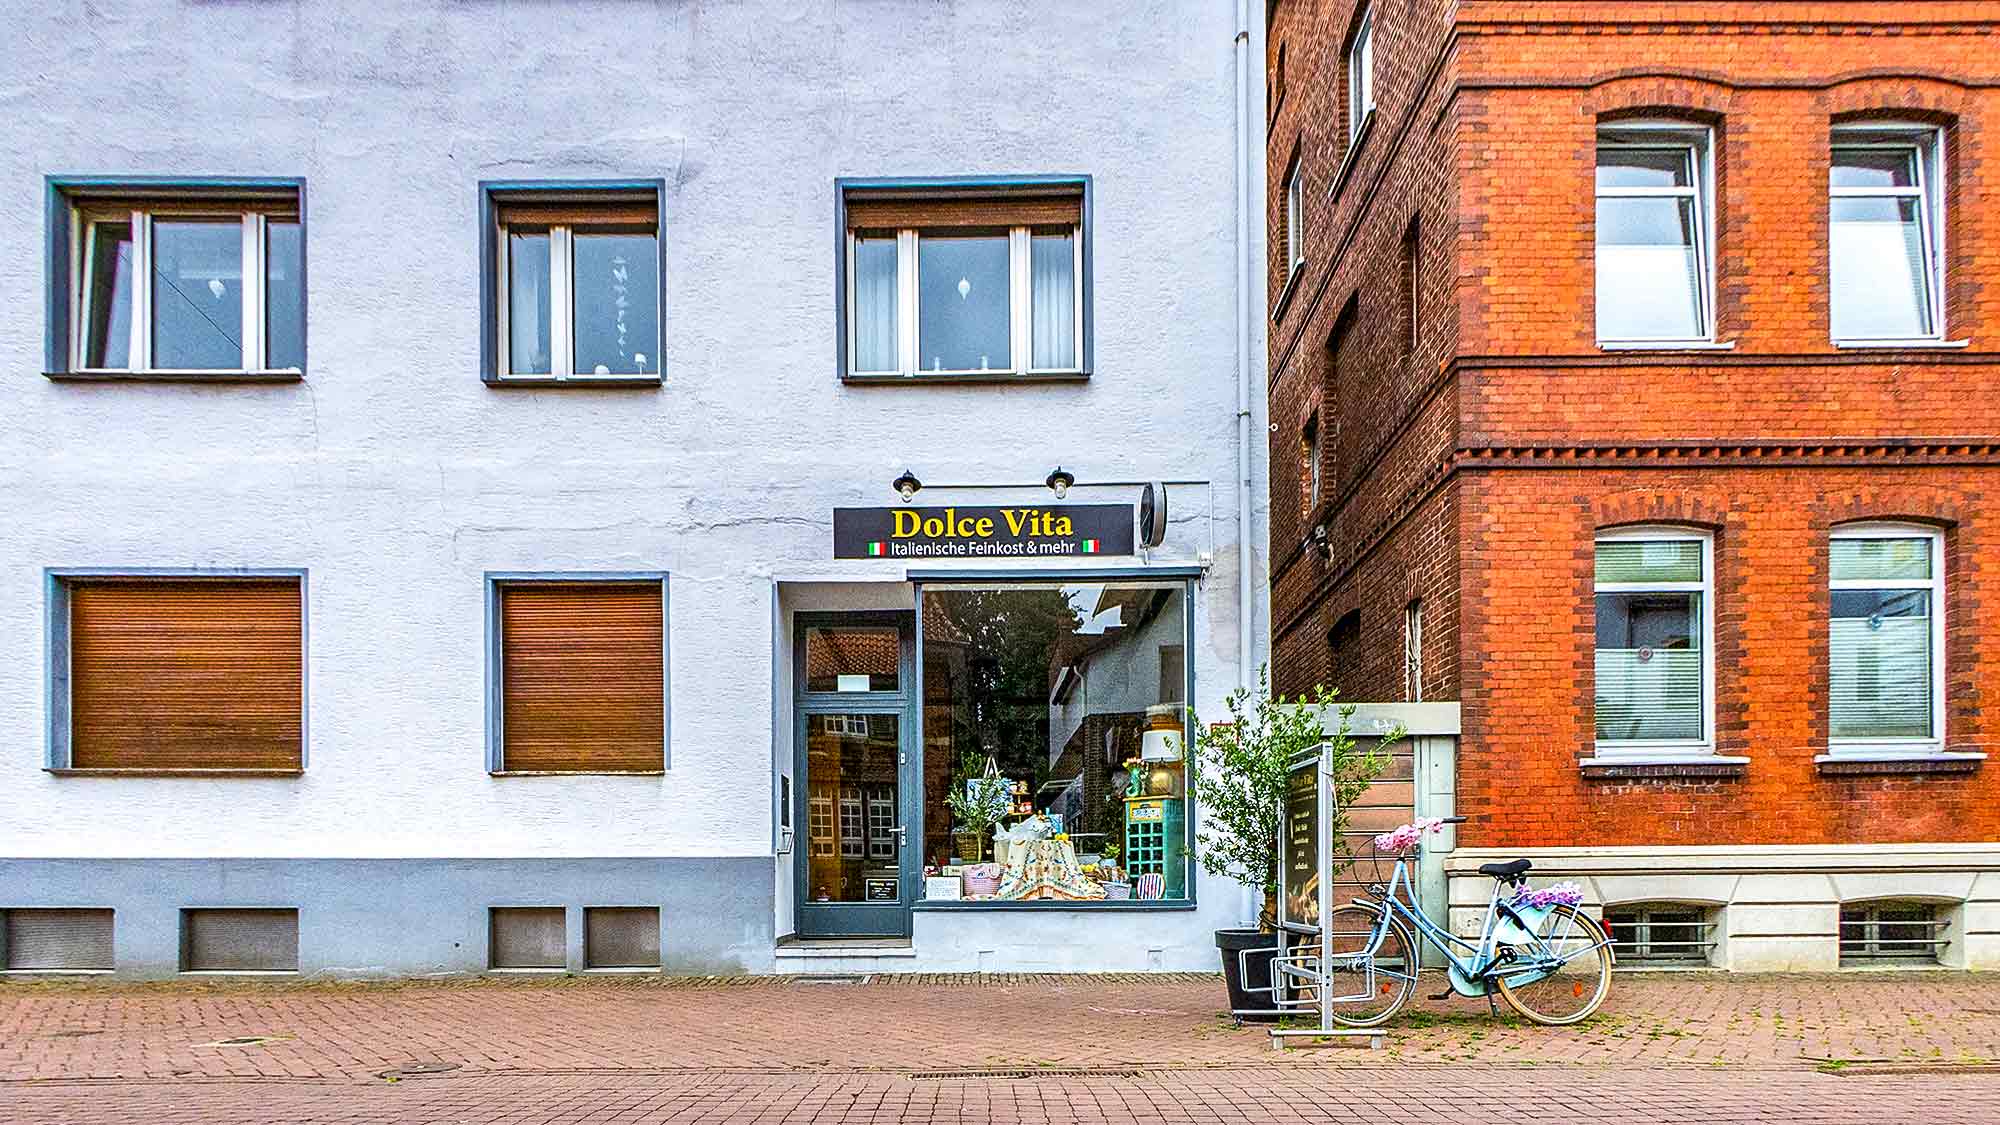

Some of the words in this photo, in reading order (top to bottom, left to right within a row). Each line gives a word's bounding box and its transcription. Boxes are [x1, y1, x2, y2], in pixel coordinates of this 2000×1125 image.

[891, 508, 993, 538] Dolce
[1000, 509, 1074, 537] Vita
[891, 541, 965, 555] Italienische
[968, 541, 1025, 554] Feinkost
[1027, 541, 1037, 554] &
[1040, 540, 1075, 553] mehr
